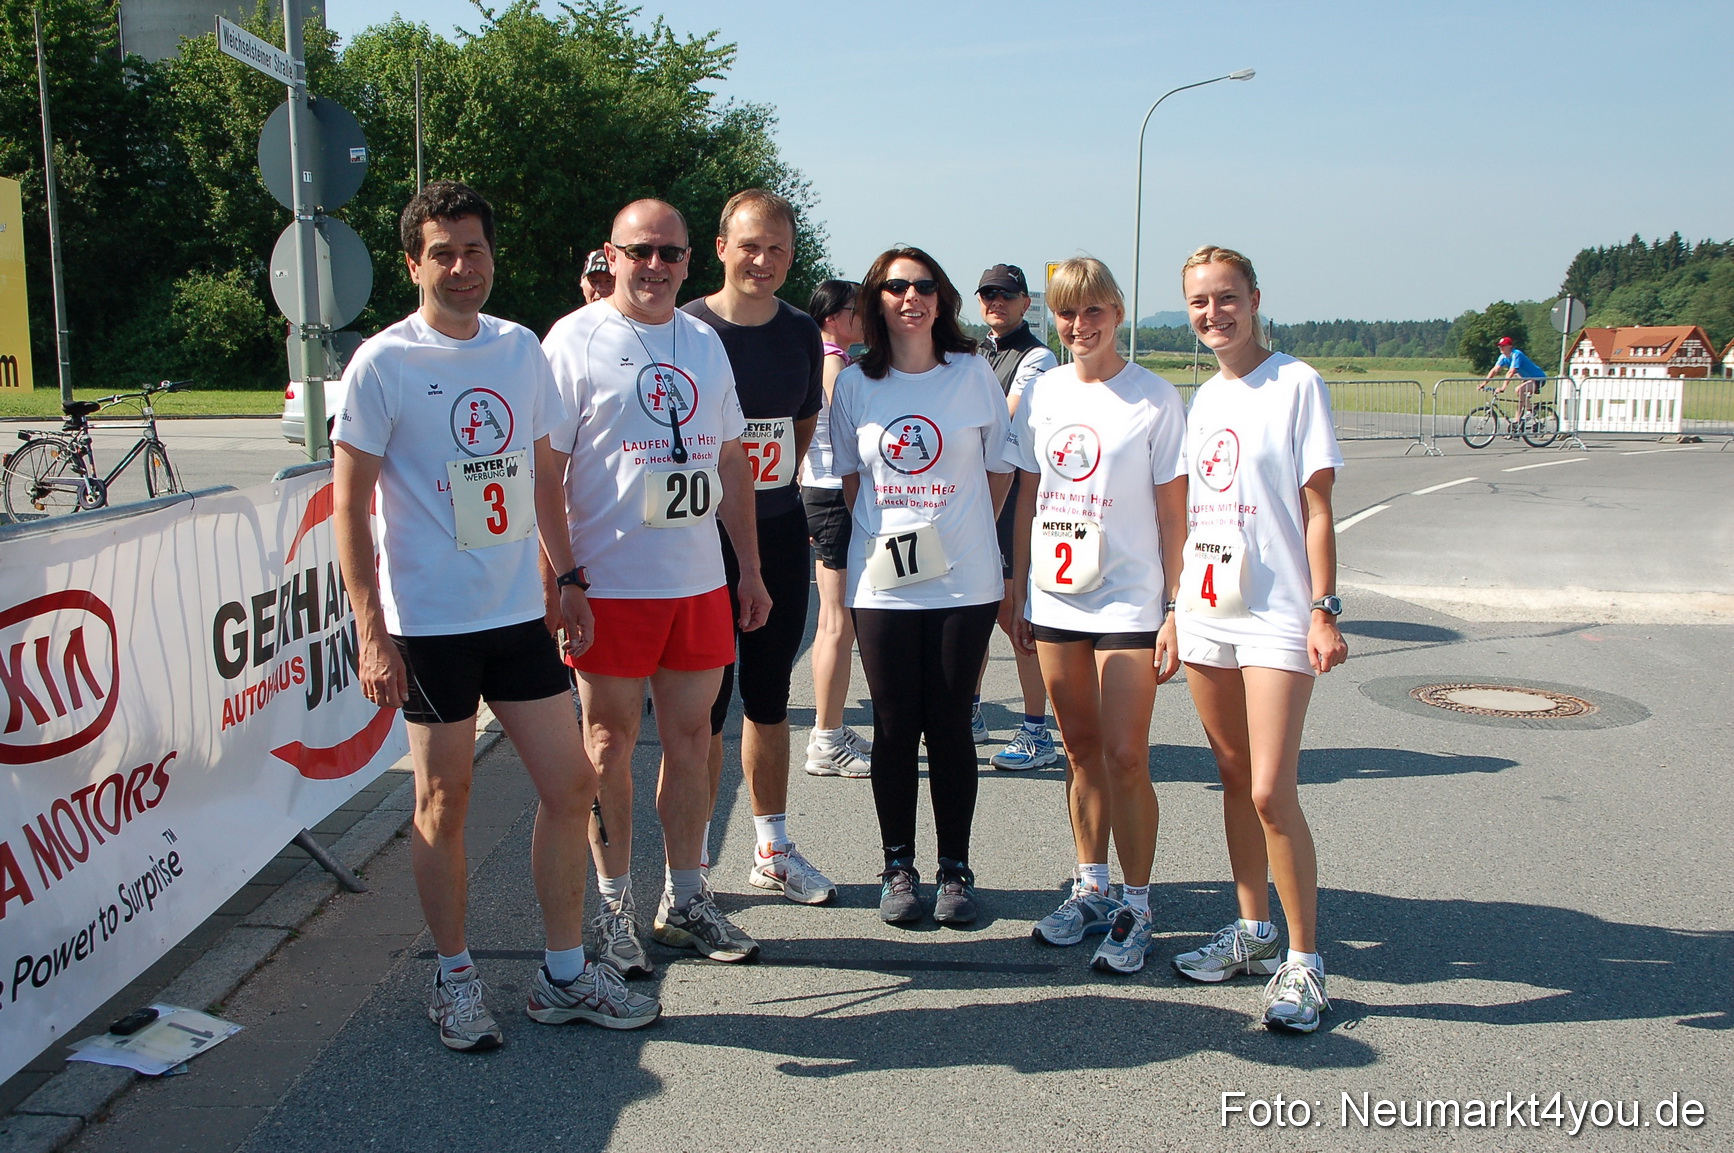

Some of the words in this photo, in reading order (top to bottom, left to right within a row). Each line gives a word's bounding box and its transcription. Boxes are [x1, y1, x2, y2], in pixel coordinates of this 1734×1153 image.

[222, 24, 272, 69] Weichselsteiner
[274, 53, 293, 80] Straße
[623, 439, 669, 452] LAUFEN
[681, 437, 694, 448] IT
[744, 422, 772, 432] EYER
[463, 459, 504, 474] MEYER
[465, 470, 505, 482] WERBUNG
[650, 455, 671, 464] Heck
[742, 441, 781, 482] 52
[483, 482, 509, 534] 3
[666, 470, 710, 520] 20
[907, 486, 926, 495] MIT
[1039, 491, 1066, 500] AUFEN
[1070, 493, 1086, 503] MIT
[1043, 522, 1072, 531] MEYER
[1195, 542, 1220, 553] MEYER
[885, 531, 918, 578] 17
[1055, 542, 1073, 585] 2
[1201, 564, 1218, 608] 4
[305, 619, 360, 712] JÄN
[222, 656, 306, 732] AUTOHAUS
[22, 750, 178, 891] MOTORS
[11, 920, 97, 1004] Power
[98, 906, 119, 943] to
[118, 849, 184, 923] Surprise
